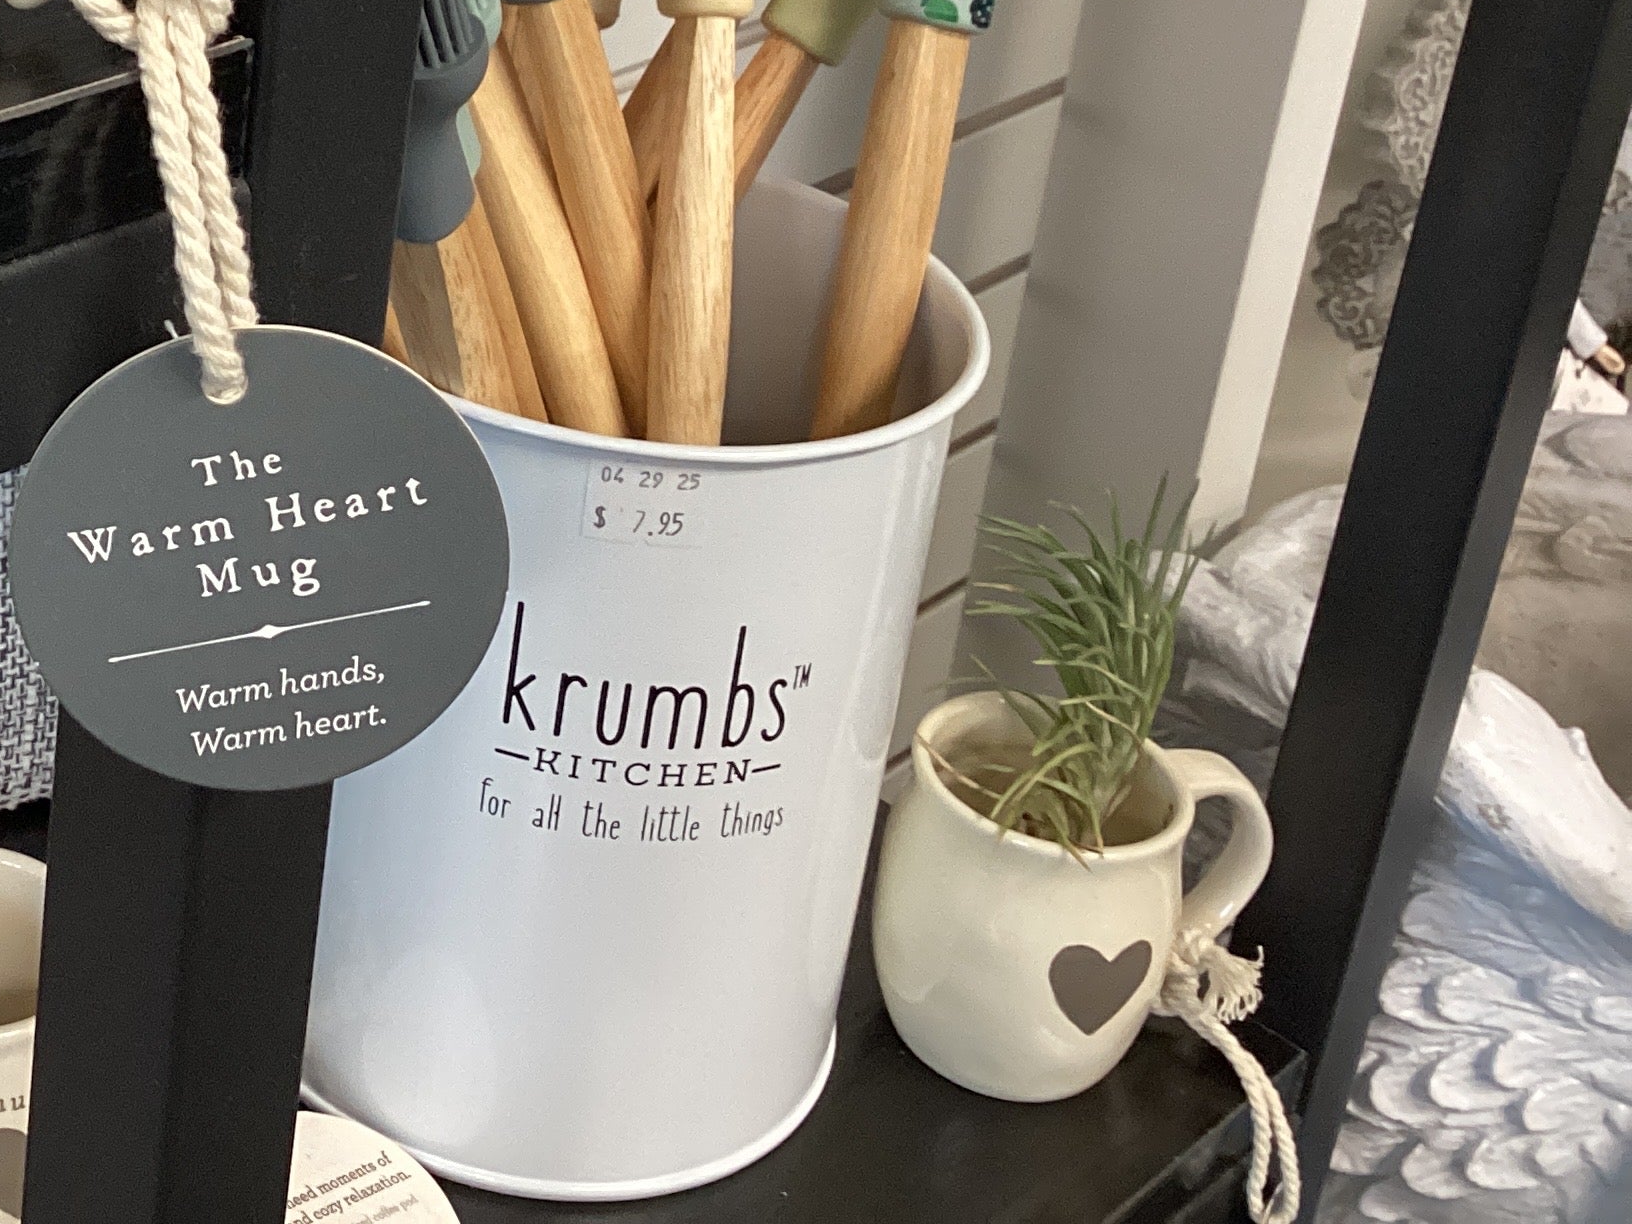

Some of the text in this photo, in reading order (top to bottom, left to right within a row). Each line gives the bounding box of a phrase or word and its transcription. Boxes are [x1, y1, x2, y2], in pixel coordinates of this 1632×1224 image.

[191, 450, 283, 487] The
[601, 466, 701, 491] 04 29 25
[67, 477, 429, 564] Warm Heart
[632, 510, 685, 537] 7.95
[196, 556, 321, 597] Mug
[176, 655, 385, 714] Warm hands,
[191, 703, 388, 756] Warm heart.
[479, 777, 784, 842] for all the little things
[313, 1199, 344, 1220] cozy
[343, 1171, 412, 1206] relaxation.
[318, 1163, 377, 1195] moments
[377, 1150, 392, 1167] of
